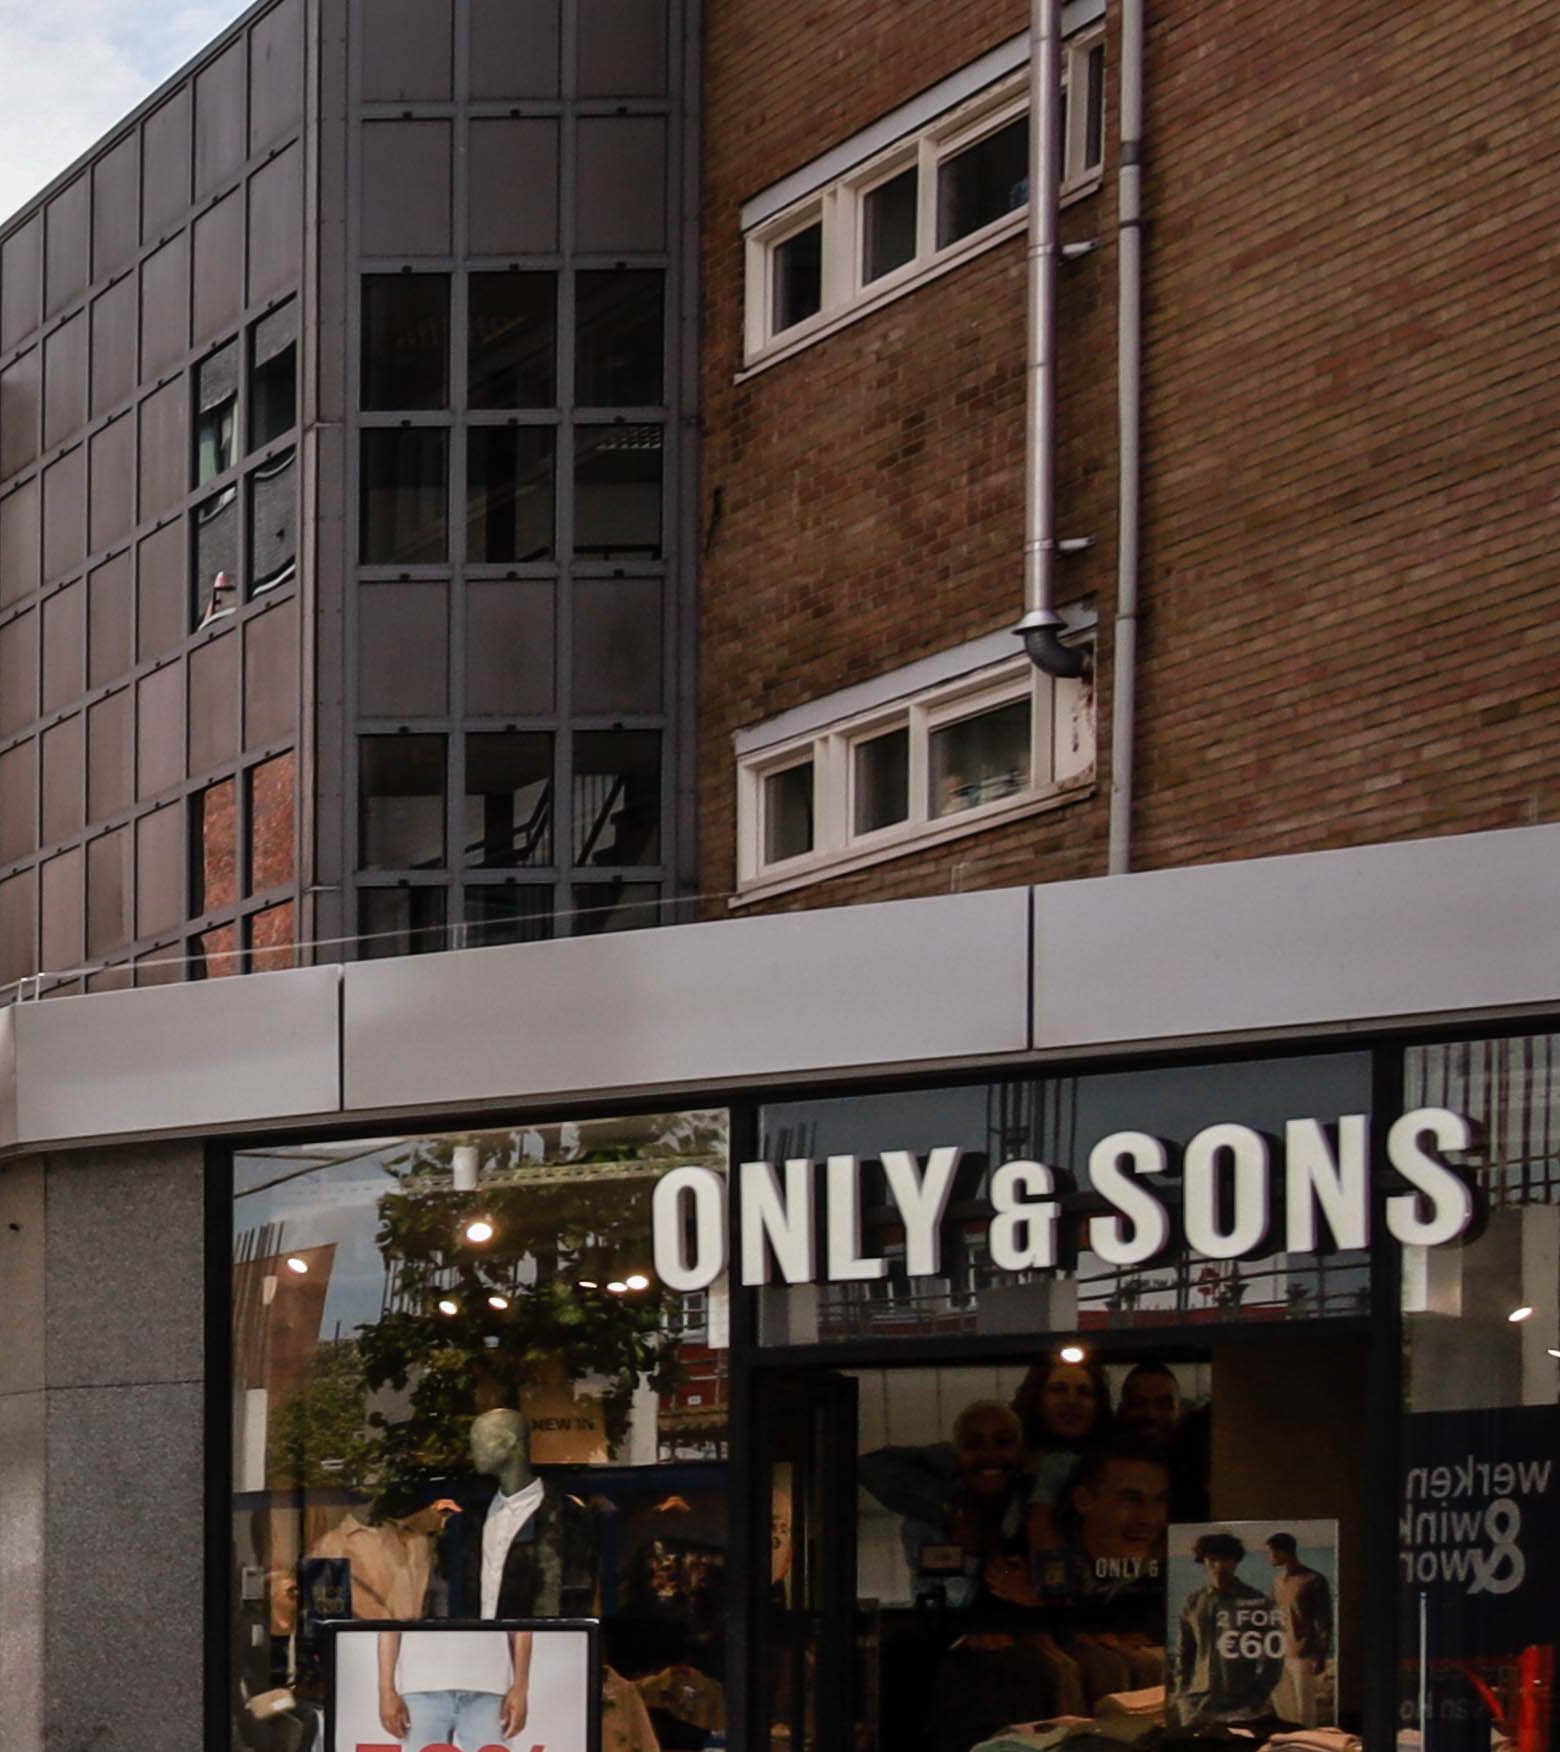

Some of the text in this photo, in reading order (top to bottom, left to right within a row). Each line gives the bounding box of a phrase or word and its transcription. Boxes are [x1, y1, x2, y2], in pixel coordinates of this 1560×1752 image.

[652, 1107, 1474, 1292] ONLY & SONS
[531, 1417, 571, 1431] NEW
[1095, 1558, 1140, 1578] ONLY
[1236, 1609, 1286, 1627] FOR
[1216, 1630, 1286, 1660] €60
